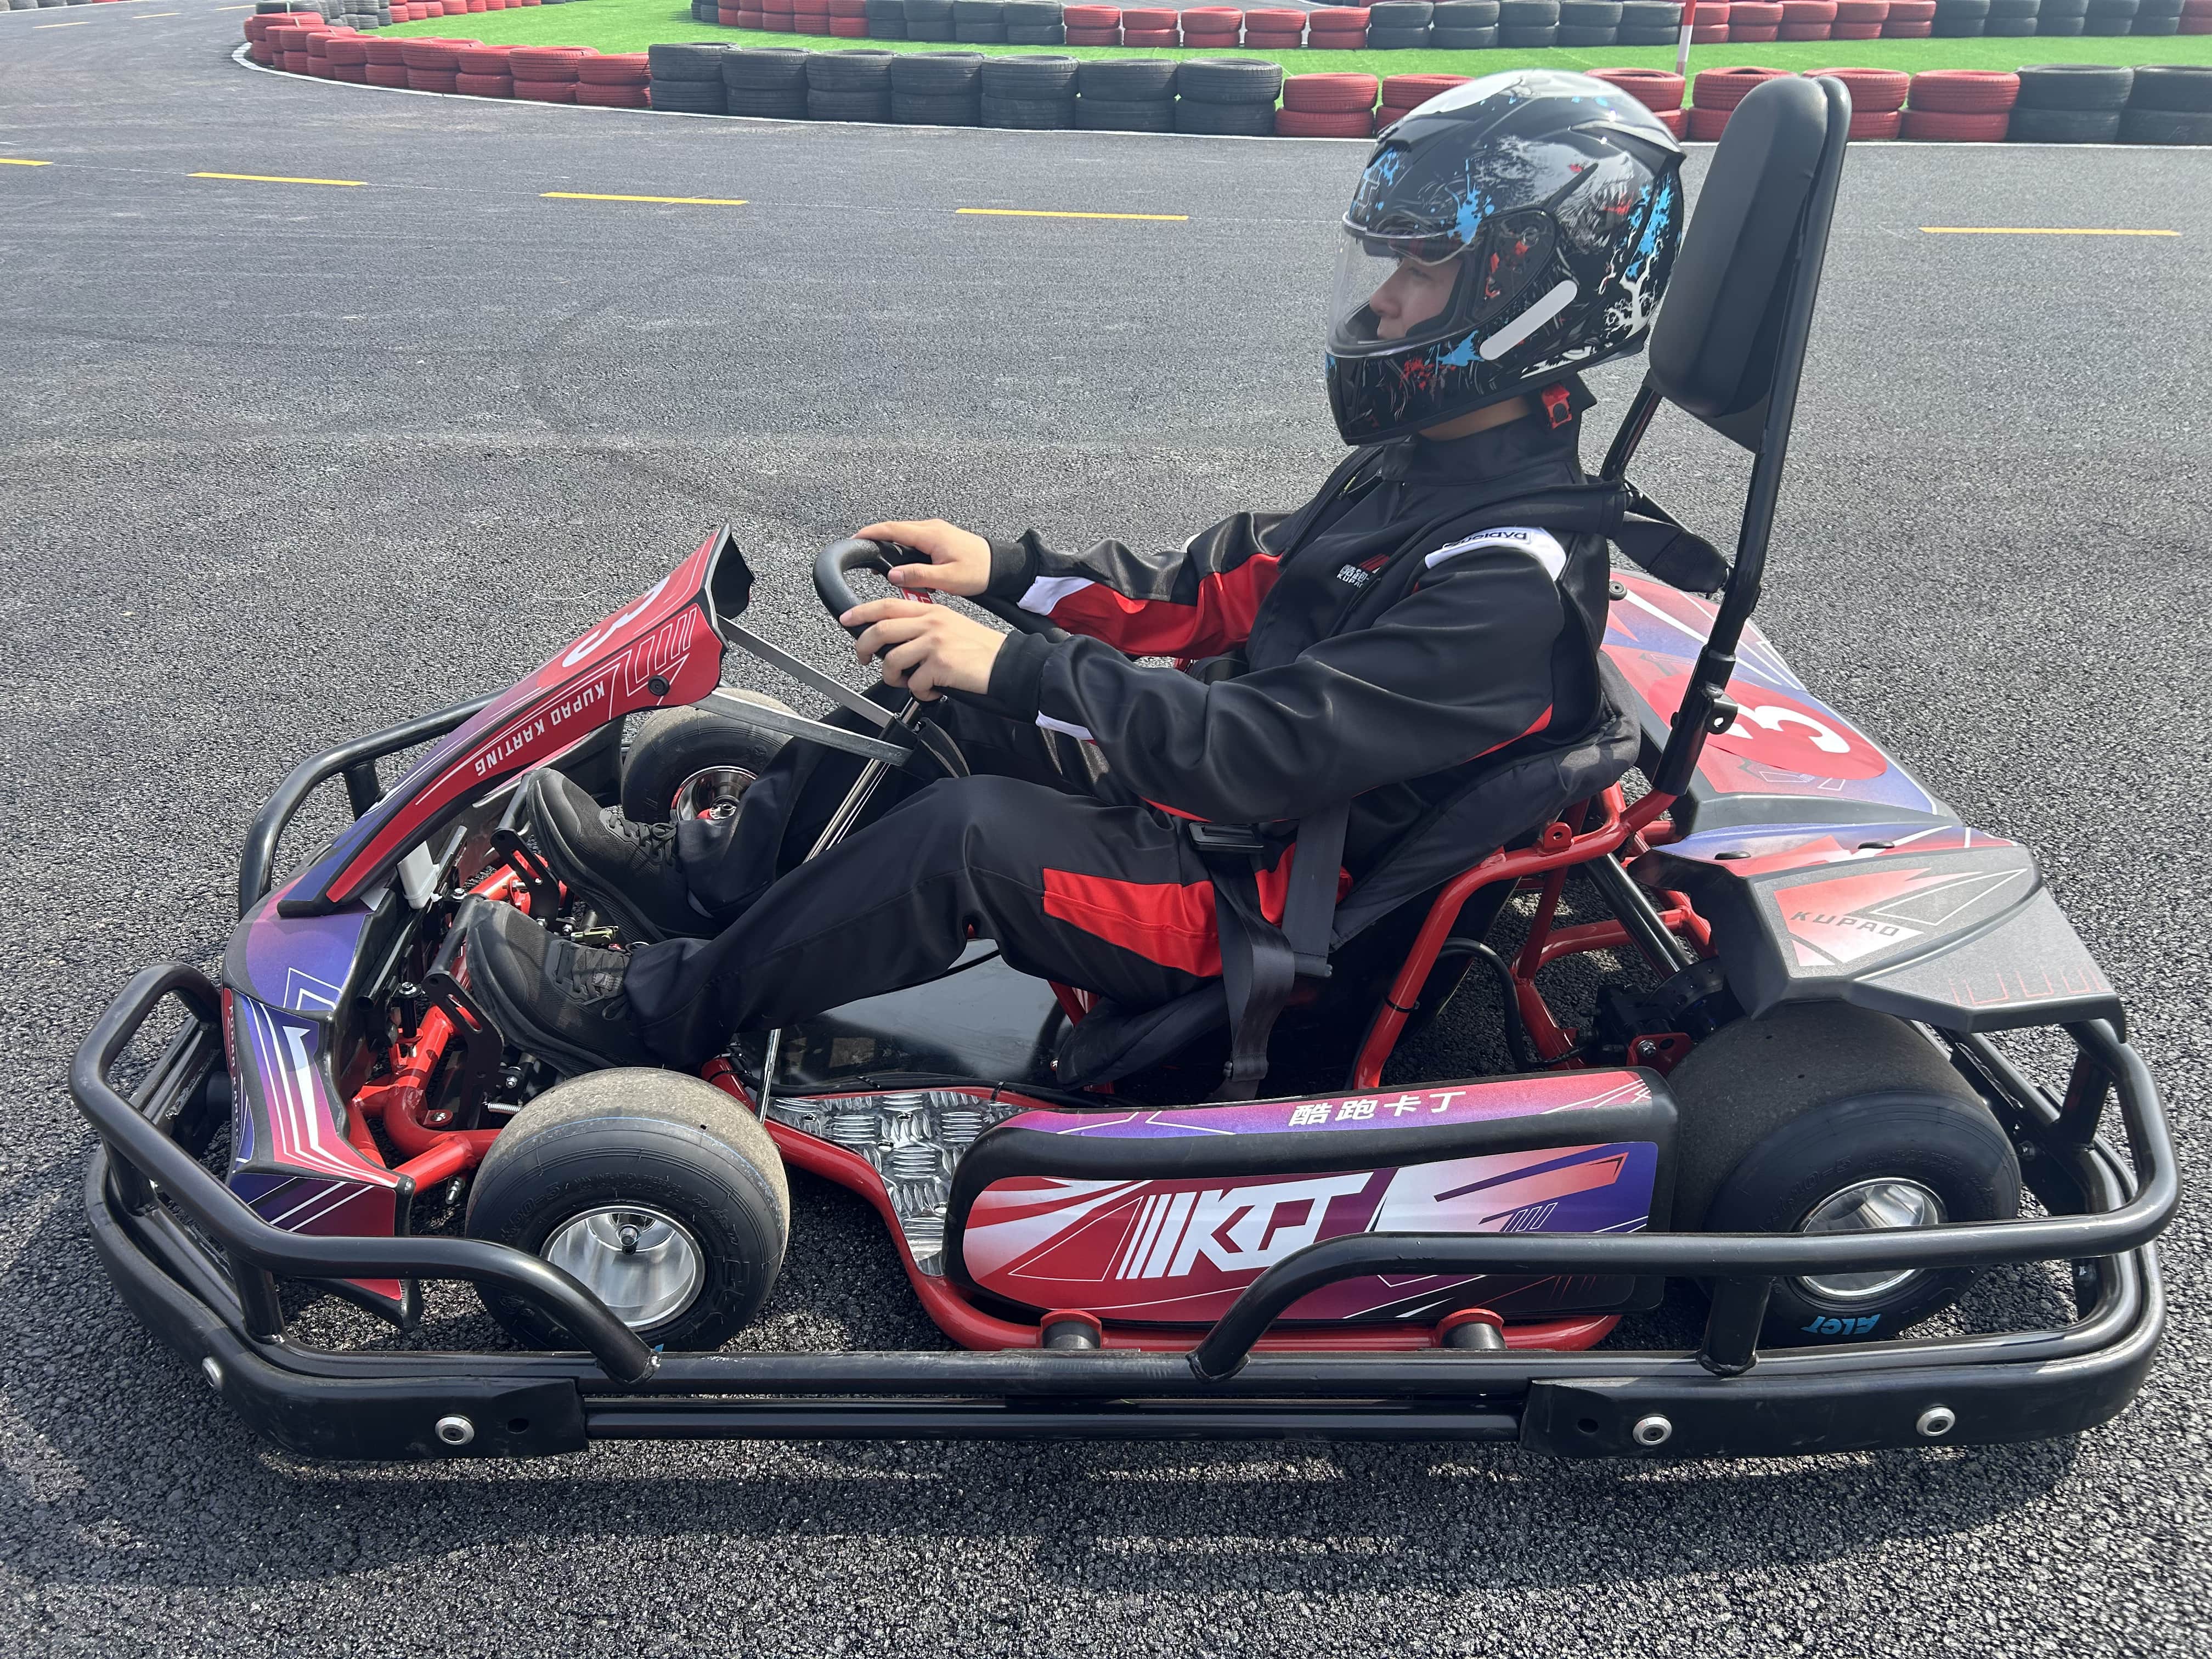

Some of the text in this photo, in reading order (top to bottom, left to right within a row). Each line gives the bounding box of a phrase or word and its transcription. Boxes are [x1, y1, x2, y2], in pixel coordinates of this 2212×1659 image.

[475, 680, 605, 776] KUPAO KARTING
[1790, 911, 1900, 936] KUPAO
[1288, 1091, 1466, 1126] 酷跑卡丁
